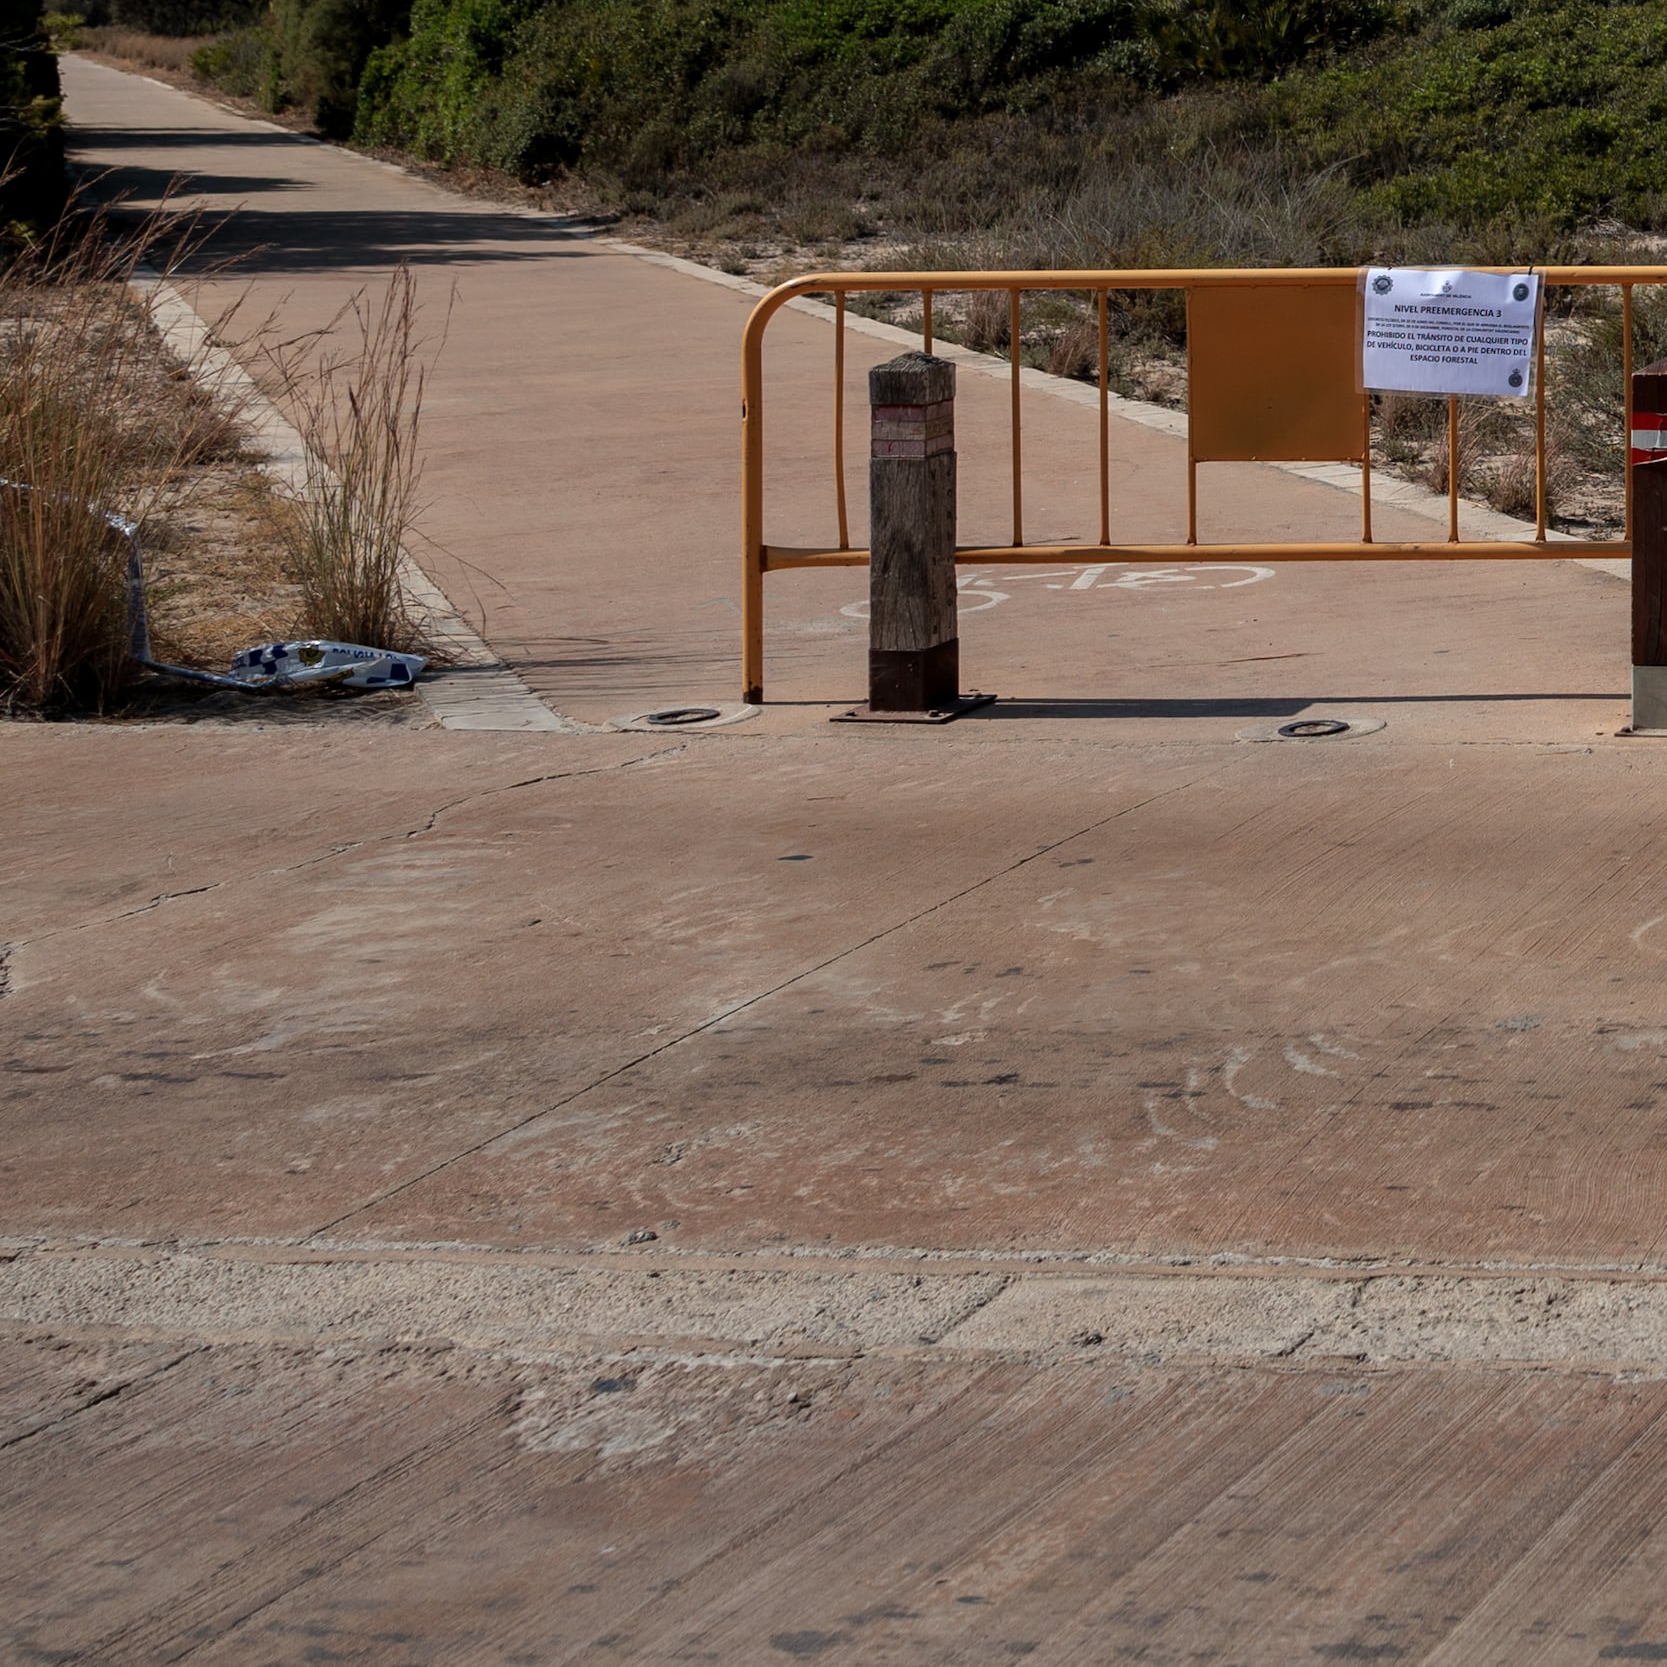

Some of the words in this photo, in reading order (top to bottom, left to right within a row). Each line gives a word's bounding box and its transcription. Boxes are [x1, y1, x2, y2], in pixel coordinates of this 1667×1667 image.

[1394, 304, 1419, 314] NIVEL
[1420, 306, 1495, 317] PREEMERGENCIA
[1496, 309, 1502, 317] 3
[1367, 330, 1406, 340] PROHIBIDO
[1417, 332, 1453, 342] TRÁNSITO
[1466, 336, 1509, 345] CUALQUIER
[1511, 337, 1529, 345] TIPO
[1377, 339, 1414, 351] VEHÍCULO,
[1415, 344, 1451, 353] BICICLETA
[1480, 347, 1512, 356] DENTRO
[1513, 348, 1527, 356] DEL
[1410, 354, 1441, 363] ESPACIO
[1441, 356, 1478, 365] FORESTAL
